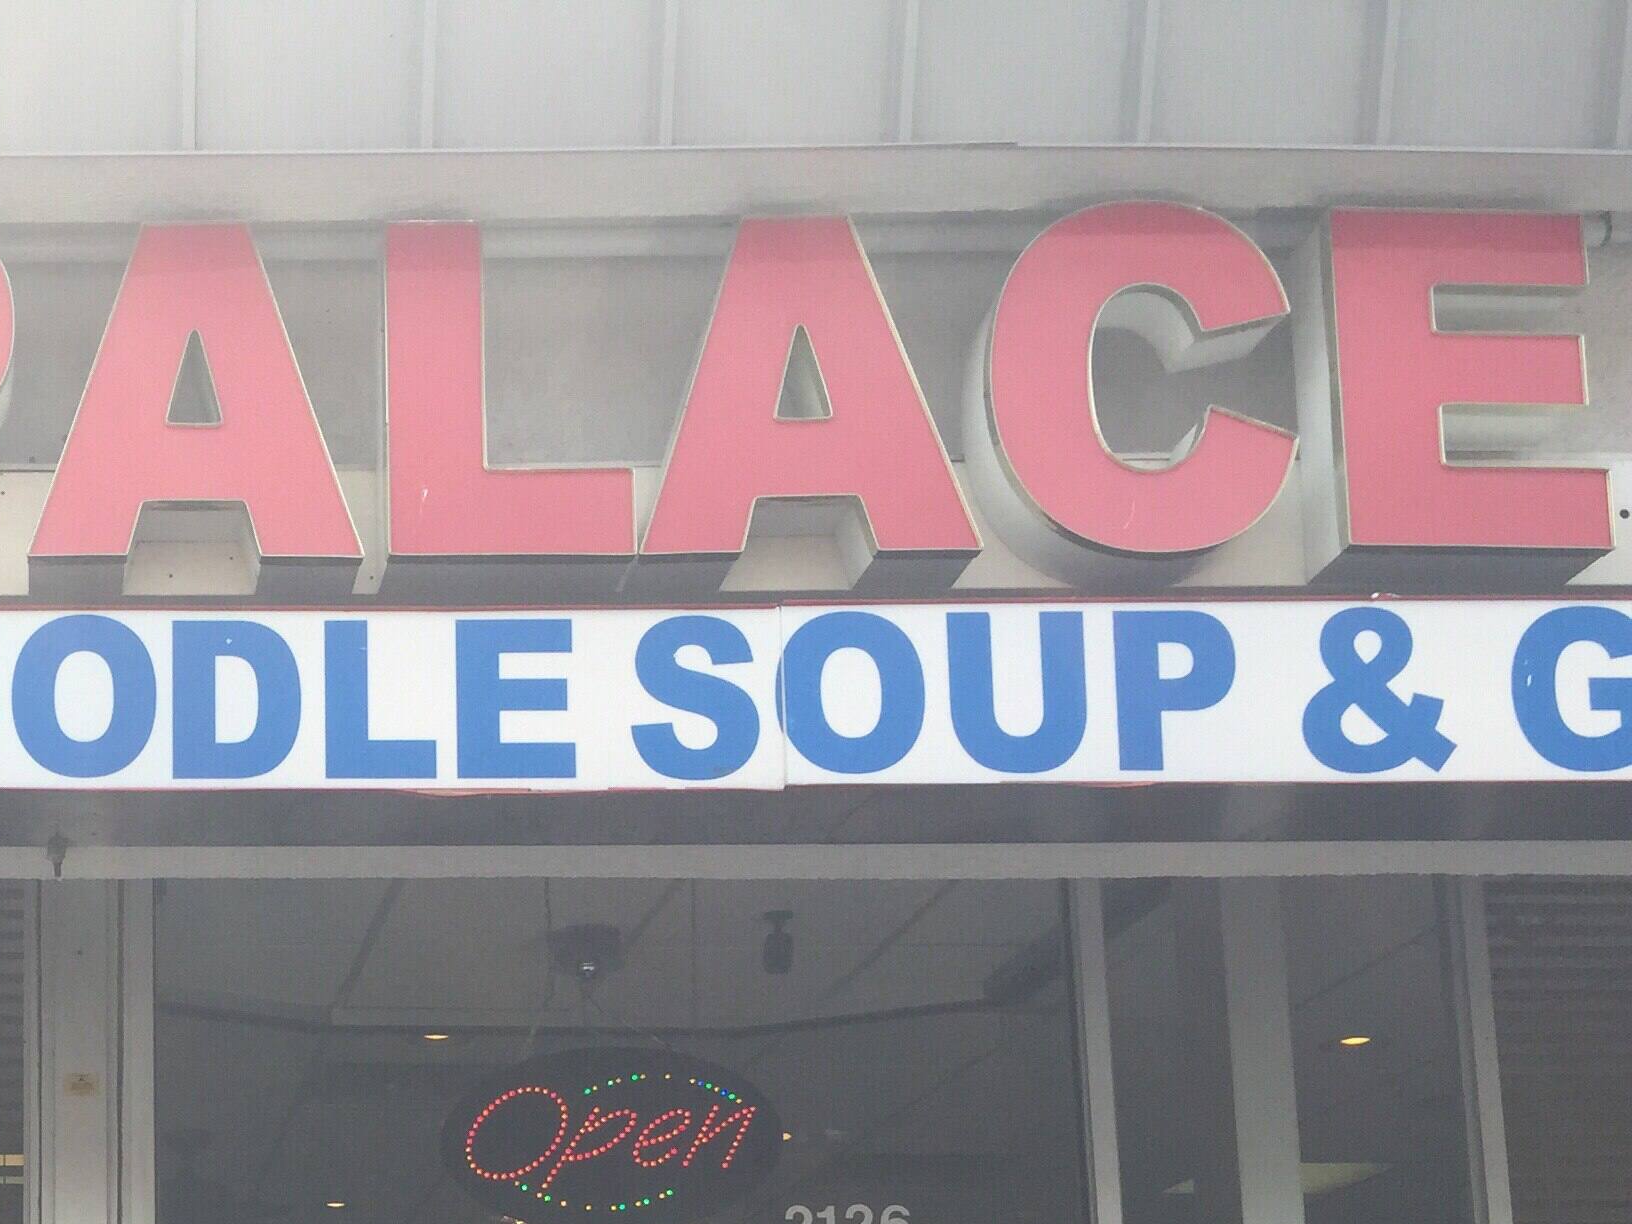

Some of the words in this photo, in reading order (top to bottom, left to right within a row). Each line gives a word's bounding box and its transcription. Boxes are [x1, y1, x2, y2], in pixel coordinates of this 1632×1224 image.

[631, 611, 1235, 780] SOUP
[1302, 607, 1457, 774] &
[466, 1086, 756, 1188] Open
